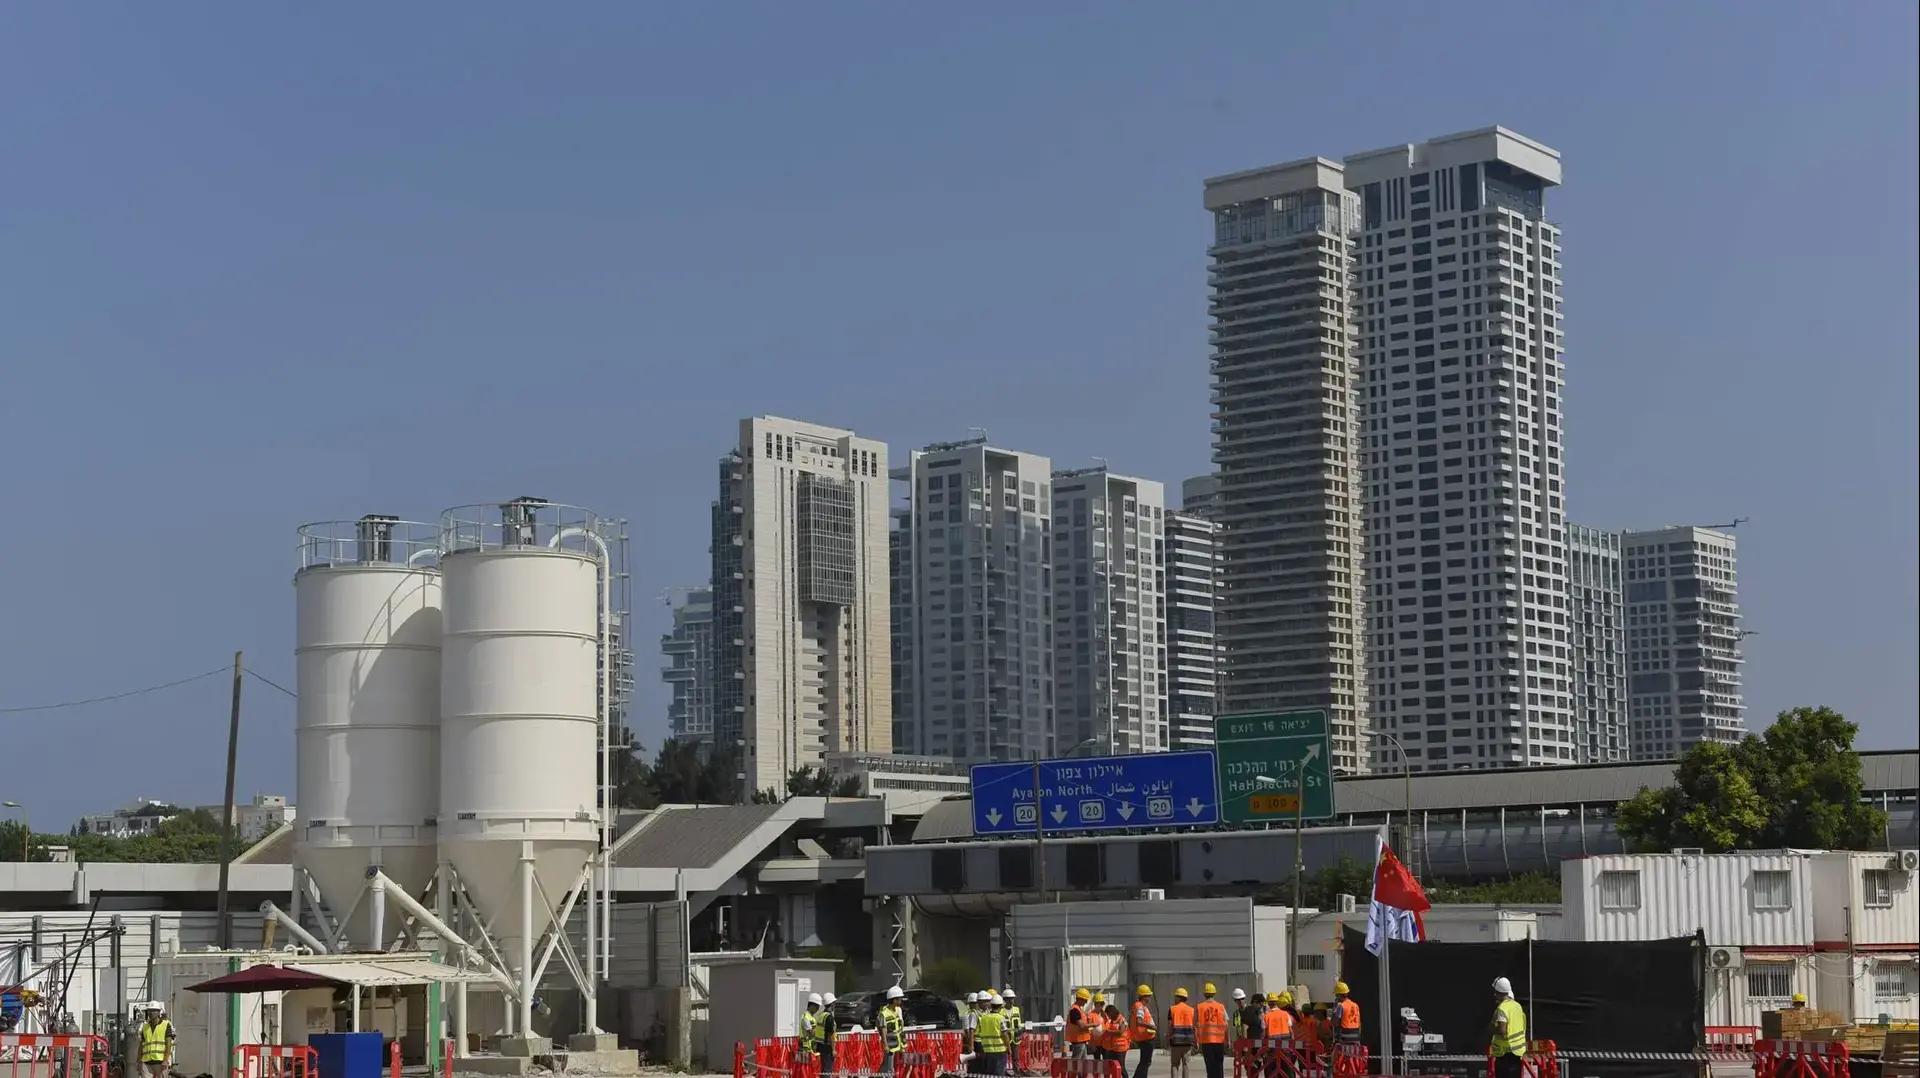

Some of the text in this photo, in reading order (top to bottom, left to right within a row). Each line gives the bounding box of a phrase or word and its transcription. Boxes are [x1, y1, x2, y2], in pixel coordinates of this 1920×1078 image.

[1231, 721, 1275, 733] EXIT 16
[1281, 719, 1310, 730] יציאה
[1056, 764, 1123, 780] איילון צפון
[1227, 761, 1267, 775] ההלכה
[1307, 776, 1322, 787] St
[1012, 784, 1093, 801] Ayaon North
[1106, 781, 1134, 796] شمال
[1086, 806, 1099, 817] 20
[1153, 802, 1167, 813] 20
[1020, 809, 1033, 820] 20
